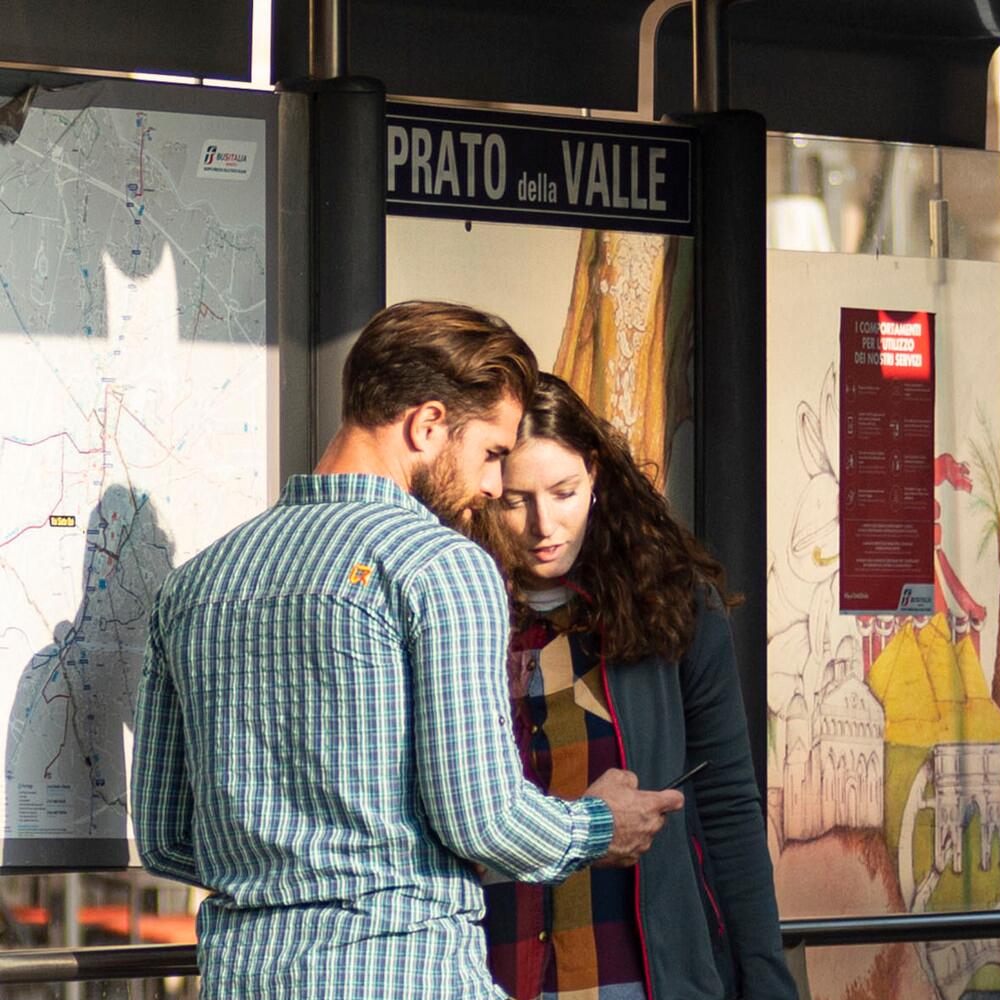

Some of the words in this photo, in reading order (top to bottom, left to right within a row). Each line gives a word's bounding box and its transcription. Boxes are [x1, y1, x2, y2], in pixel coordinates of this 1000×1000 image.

[217, 153, 247, 161] BUSITALIA
[387, 125, 507, 200] PRATO
[518, 171, 557, 203] della
[562, 140, 667, 211] VALLE
[860, 321, 922, 336] COMPORTAMENTI
[862, 337, 876, 350] PER
[855, 352, 866, 364] DEI
[867, 352, 894, 366] NOSTRI
[895, 353, 922, 367] SERVIZI
